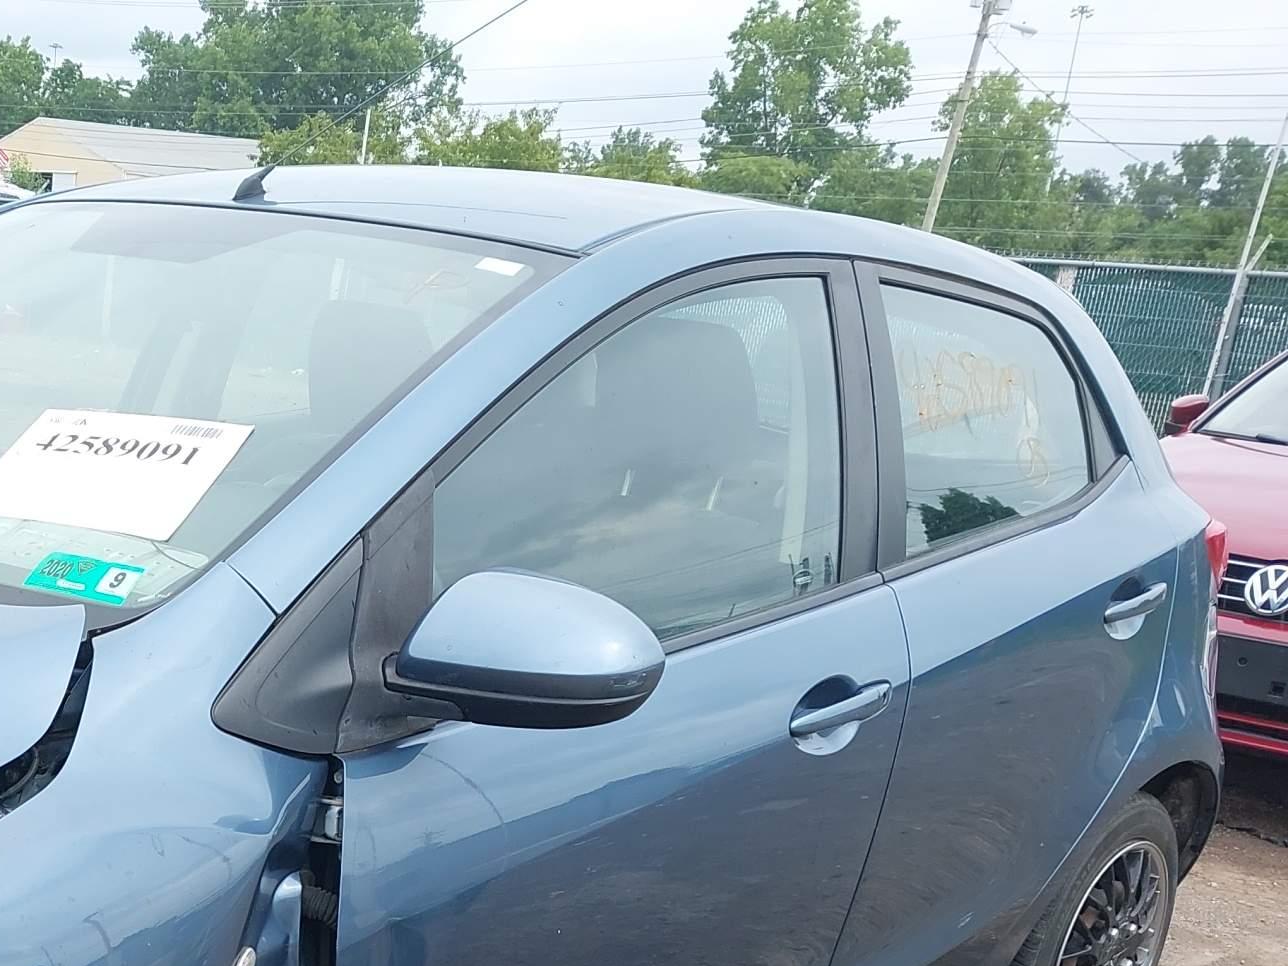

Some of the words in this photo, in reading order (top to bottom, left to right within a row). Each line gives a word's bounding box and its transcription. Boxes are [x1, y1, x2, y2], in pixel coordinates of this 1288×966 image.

[37, 433, 199, 465] 42589091
[40, 559, 74, 579] 2020
[109, 572, 127, 589] 9
